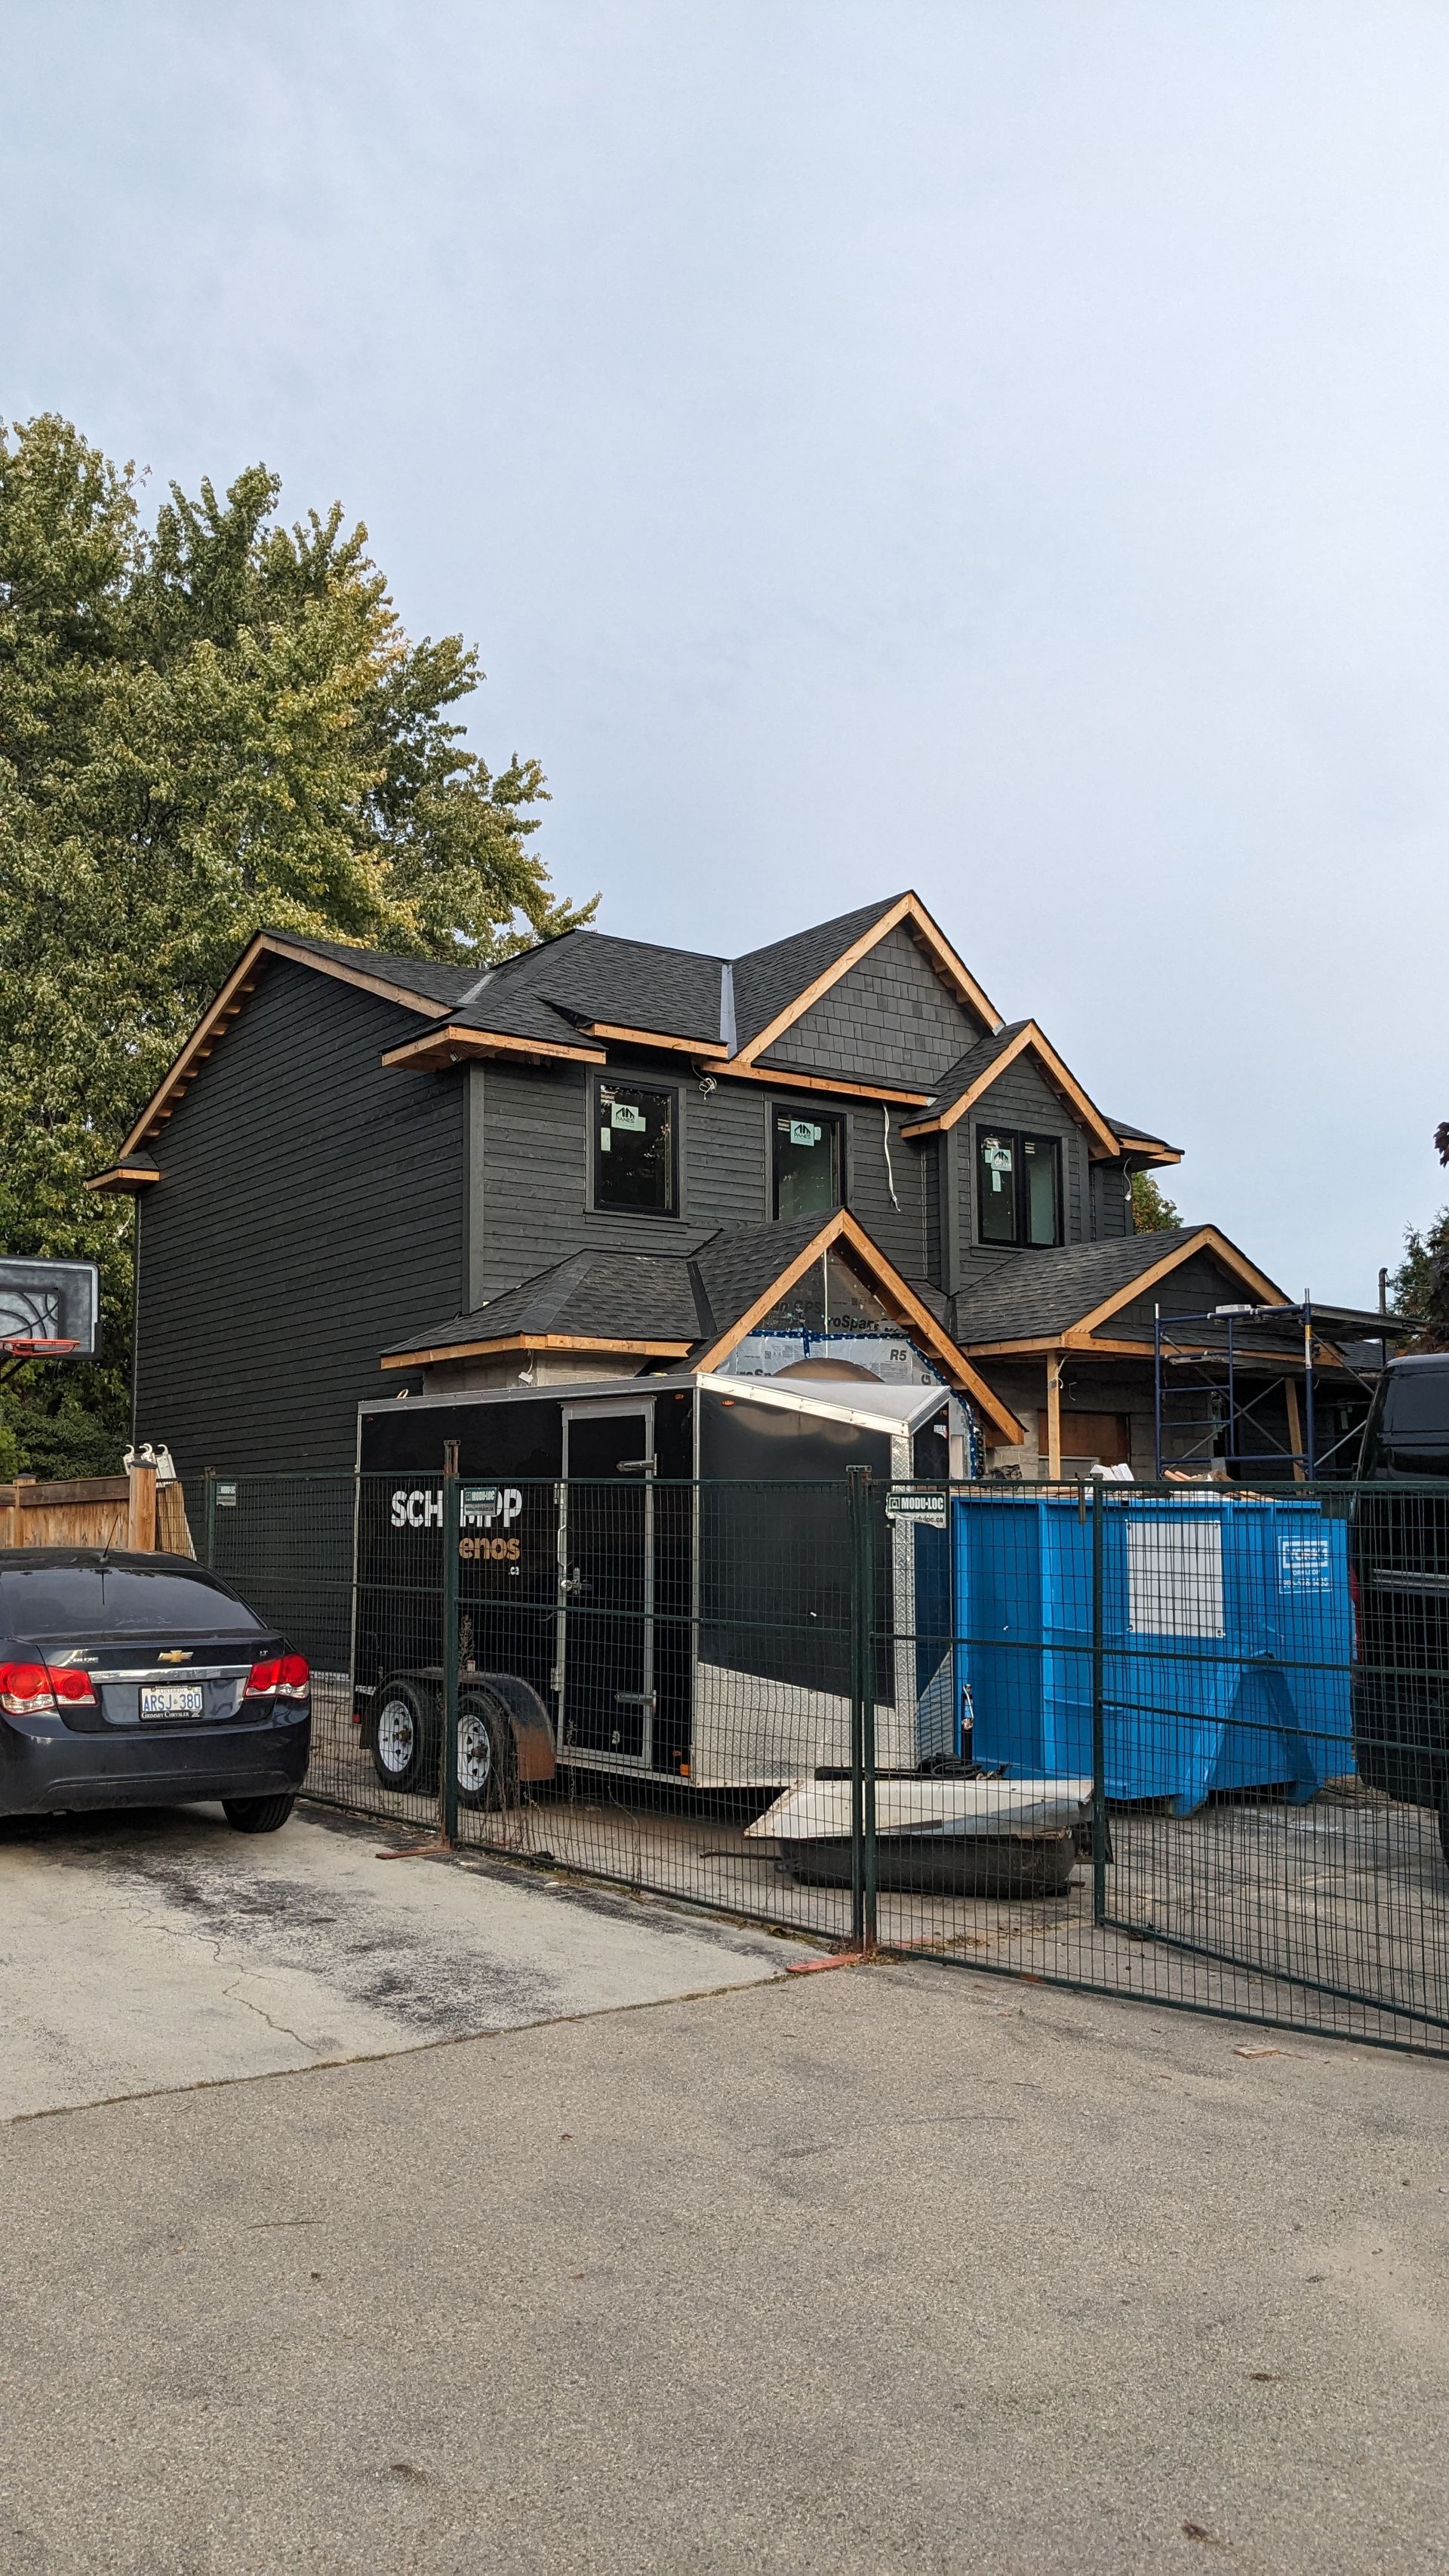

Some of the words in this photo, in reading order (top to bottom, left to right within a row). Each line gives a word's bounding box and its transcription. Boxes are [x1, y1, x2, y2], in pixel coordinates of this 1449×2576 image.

[890, 1349, 907, 1362] R5
[901, 1497, 944, 1510] MODU-LOC
[143, 1694, 172, 1712] ARSJ
[180, 1693, 202, 1710] 380
